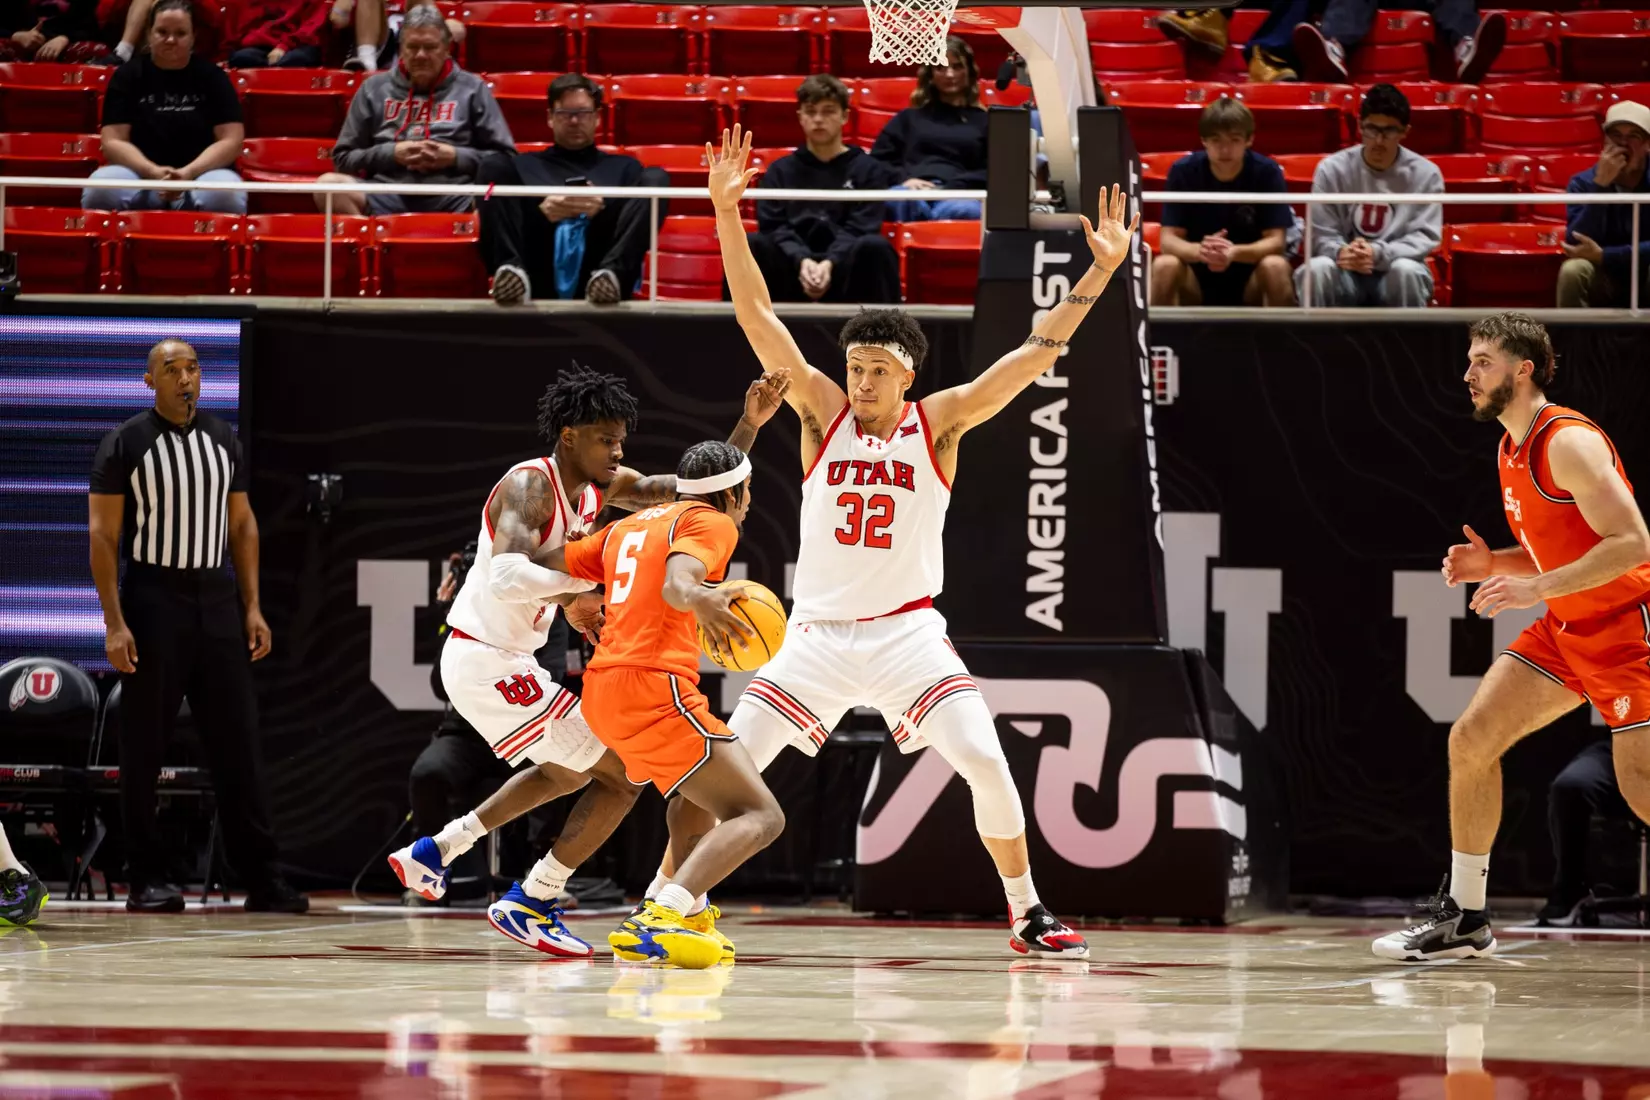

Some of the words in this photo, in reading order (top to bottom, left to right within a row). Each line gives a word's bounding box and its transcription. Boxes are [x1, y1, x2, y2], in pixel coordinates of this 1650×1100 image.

[384, 98, 457, 122] UTAH
[1361, 203, 1388, 233] U
[1032, 240, 1072, 388] FST
[827, 460, 915, 492] UTAH
[835, 492, 896, 549] 32
[1025, 397, 1069, 632] AMERICA
[610, 529, 648, 604] 5
[32, 673, 54, 696] U
[14, 768, 40, 778] CLUB
